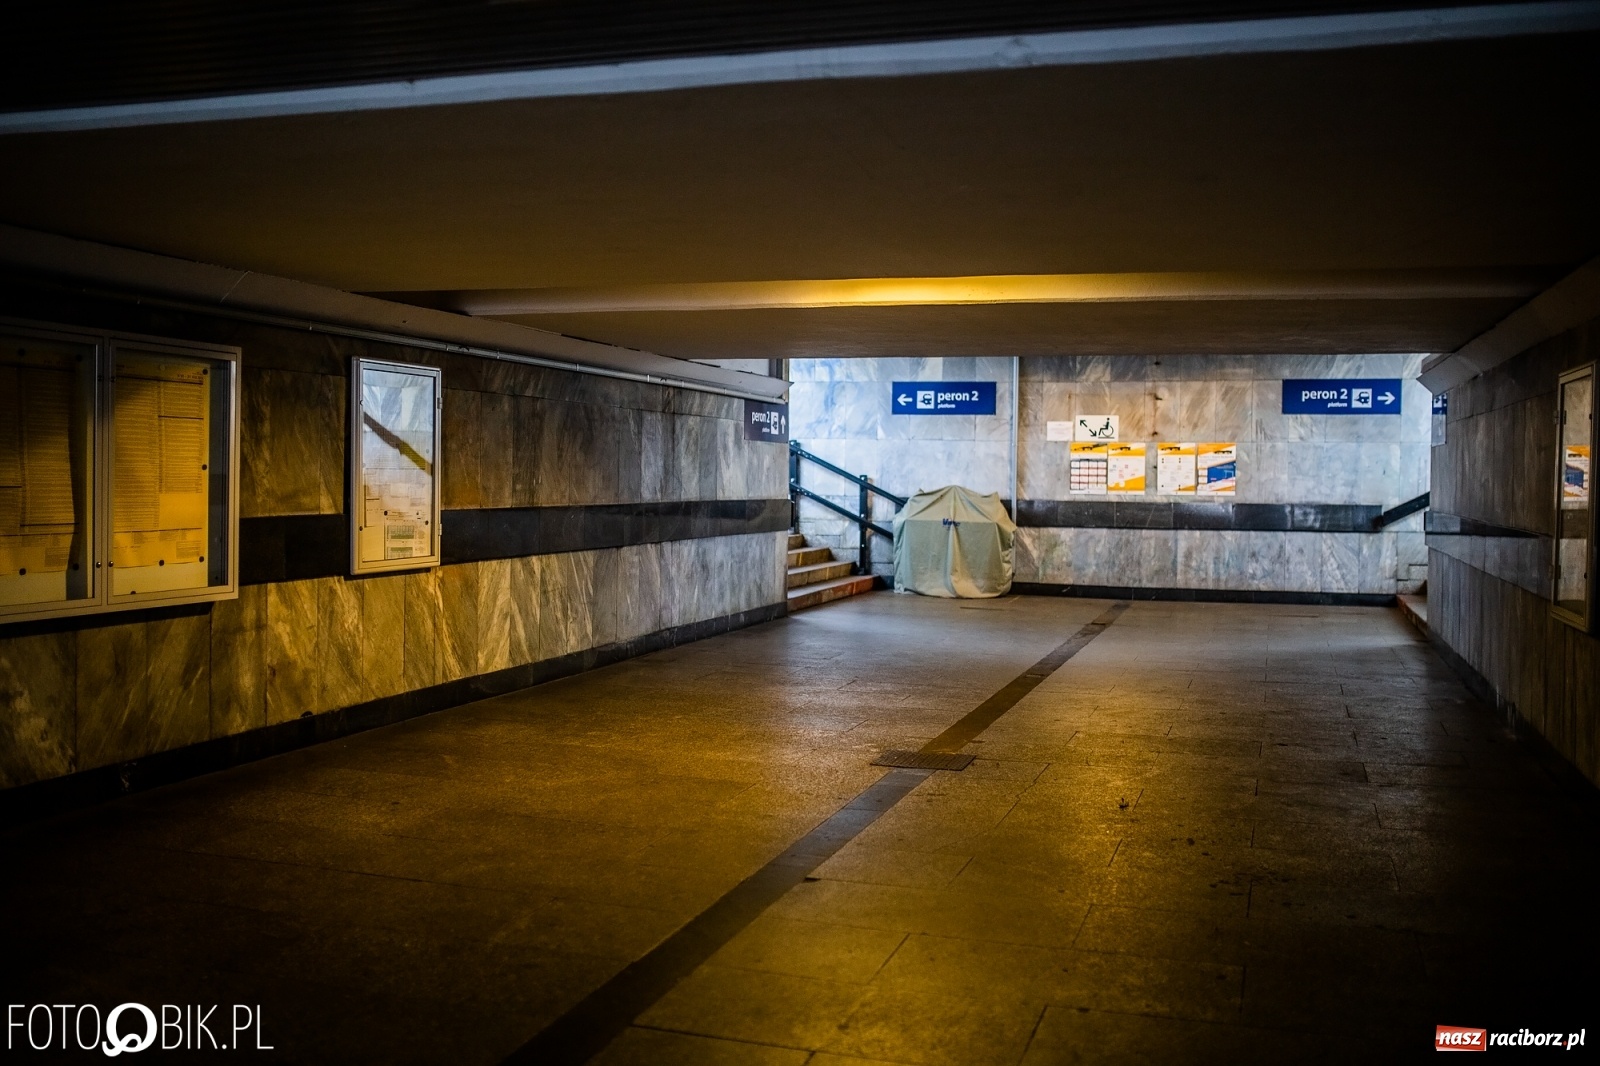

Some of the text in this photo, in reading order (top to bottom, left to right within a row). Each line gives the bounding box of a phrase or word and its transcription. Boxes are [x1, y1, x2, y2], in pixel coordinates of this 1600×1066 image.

[937, 390, 979, 403] peron 2
[1302, 388, 1348, 402] peron 2
[751, 411, 767, 425] peron
